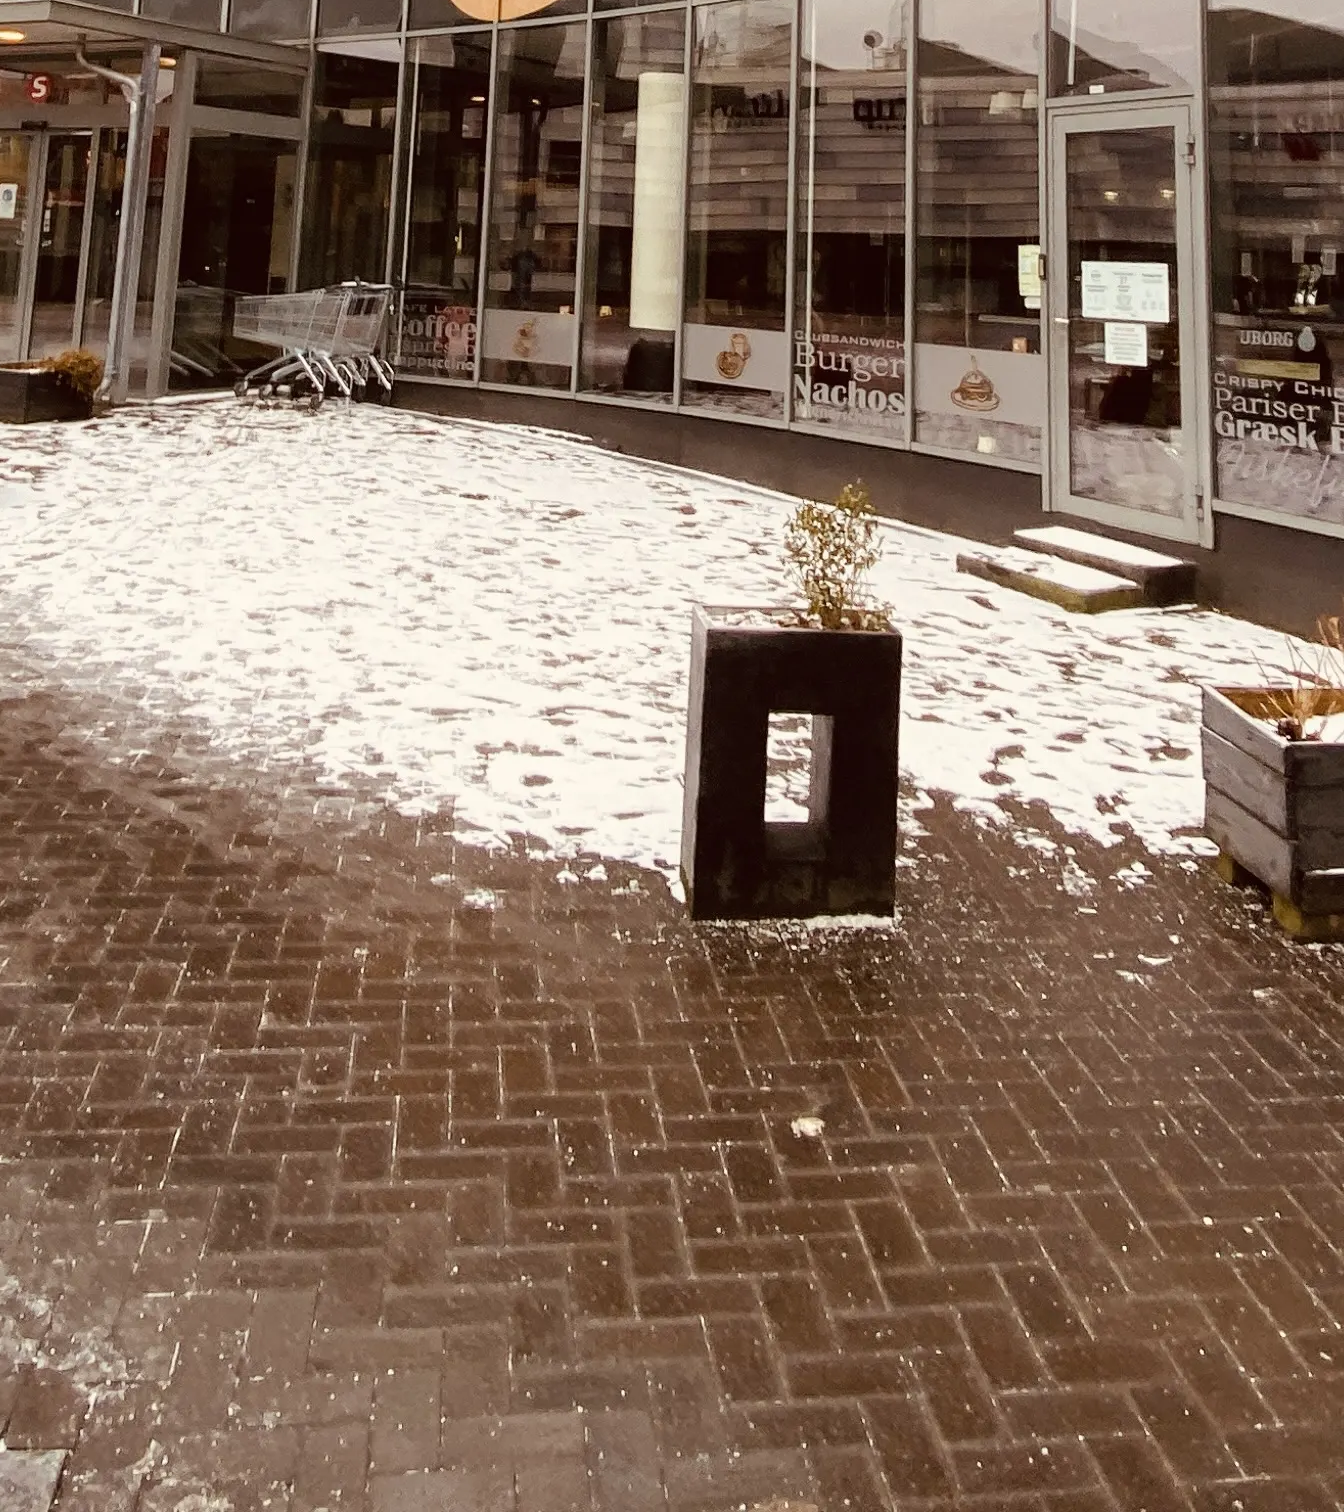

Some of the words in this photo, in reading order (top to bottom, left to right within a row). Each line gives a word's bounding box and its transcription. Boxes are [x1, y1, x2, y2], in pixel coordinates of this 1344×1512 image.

[794, 341, 905, 382] Burger
[794, 373, 905, 417] Nachos
[1214, 387, 1321, 424] Pariser
[1214, 410, 1320, 451] Græsk
